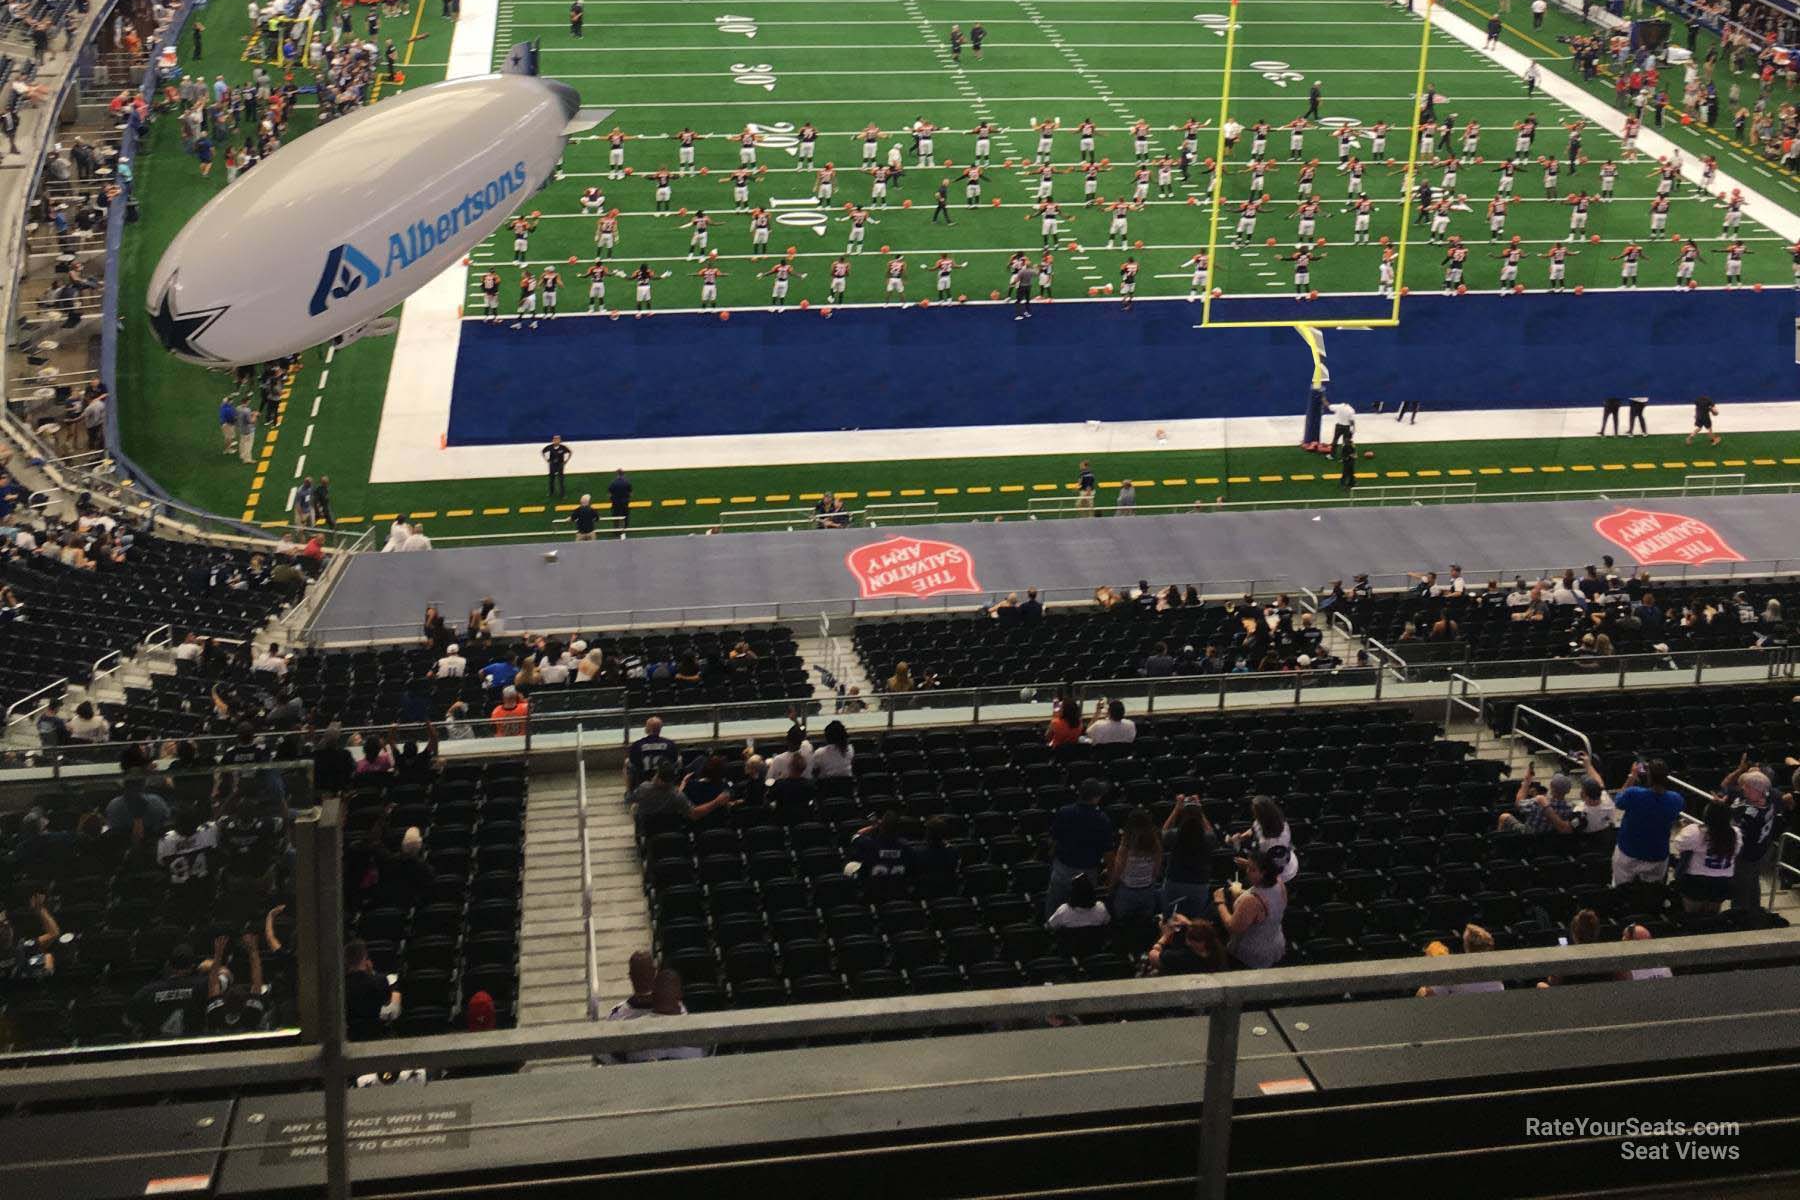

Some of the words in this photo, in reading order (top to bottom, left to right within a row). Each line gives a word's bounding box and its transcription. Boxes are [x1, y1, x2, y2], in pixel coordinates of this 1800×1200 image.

[384, 160, 527, 279] Albertsons
[1617, 514, 1663, 543] ARMY
[1630, 519, 1707, 560] SALVATION
[867, 543, 922, 574] ARMY
[1674, 539, 1715, 561] THE
[868, 548, 964, 592] SALVATION
[911, 569, 956, 593] THE
[281, 1123, 313, 1134] ANY
[316, 1116, 382, 1130] CTACT
[385, 1113, 423, 1123] WITH
[427, 1110, 457, 1120] THIS
[357, 1141, 377, 1151] TO
[380, 1134, 447, 1149] EJECTION
